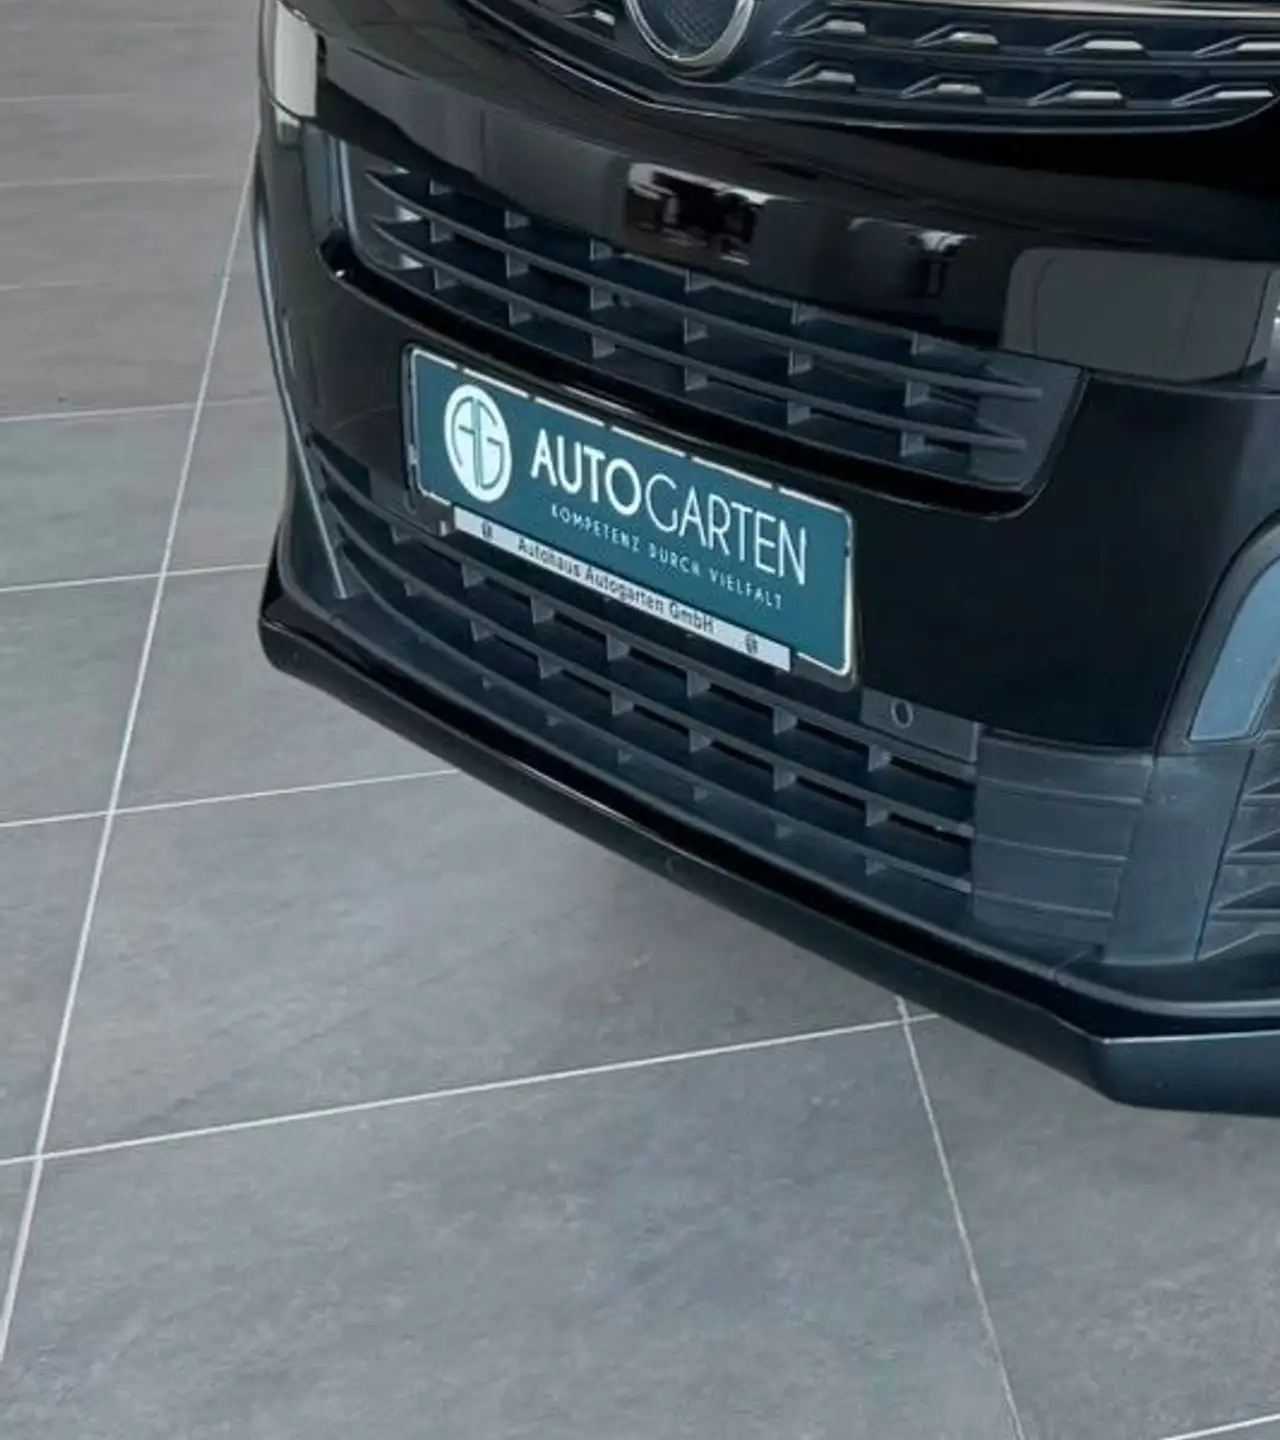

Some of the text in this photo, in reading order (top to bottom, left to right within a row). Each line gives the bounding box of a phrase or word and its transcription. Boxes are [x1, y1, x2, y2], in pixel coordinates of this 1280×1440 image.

[531, 428, 806, 586] AUTOGARTEN
[551, 503, 783, 609] KOMPETENZ DURCH VIELFALT
[518, 534, 715, 635] Autohaus Autogarten GmbH
